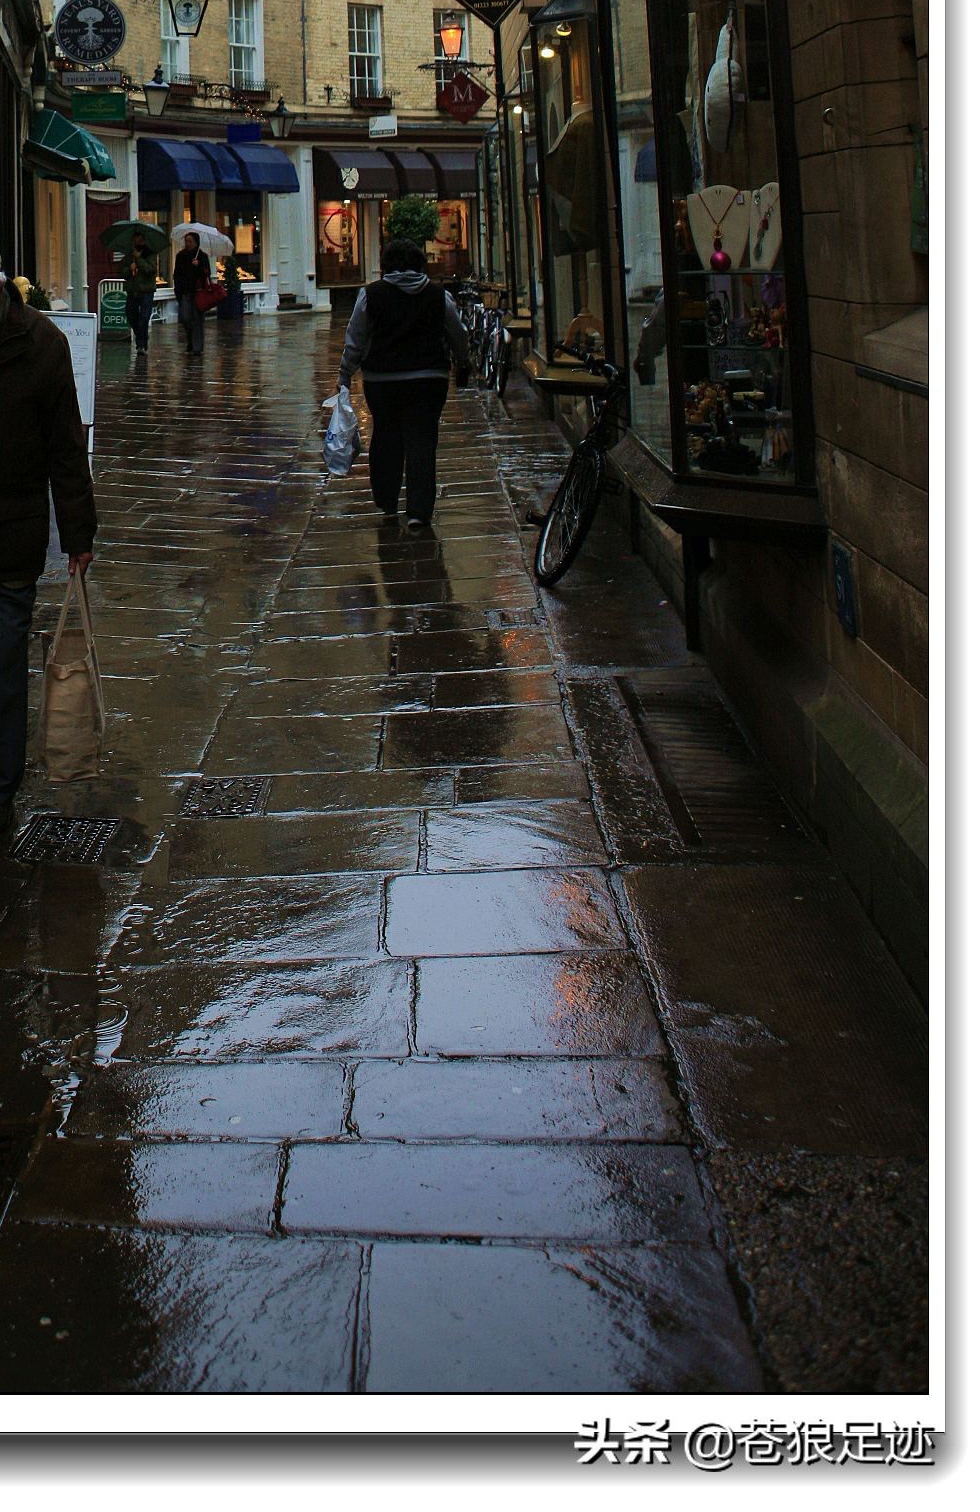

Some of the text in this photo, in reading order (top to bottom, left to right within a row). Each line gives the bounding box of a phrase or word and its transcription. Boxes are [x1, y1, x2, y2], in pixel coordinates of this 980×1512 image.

[62, 35, 120, 60] REMEDIES
[451, 83, 476, 104] M
[103, 315, 128, 324] OPEN
[74, 328, 91, 336] You
